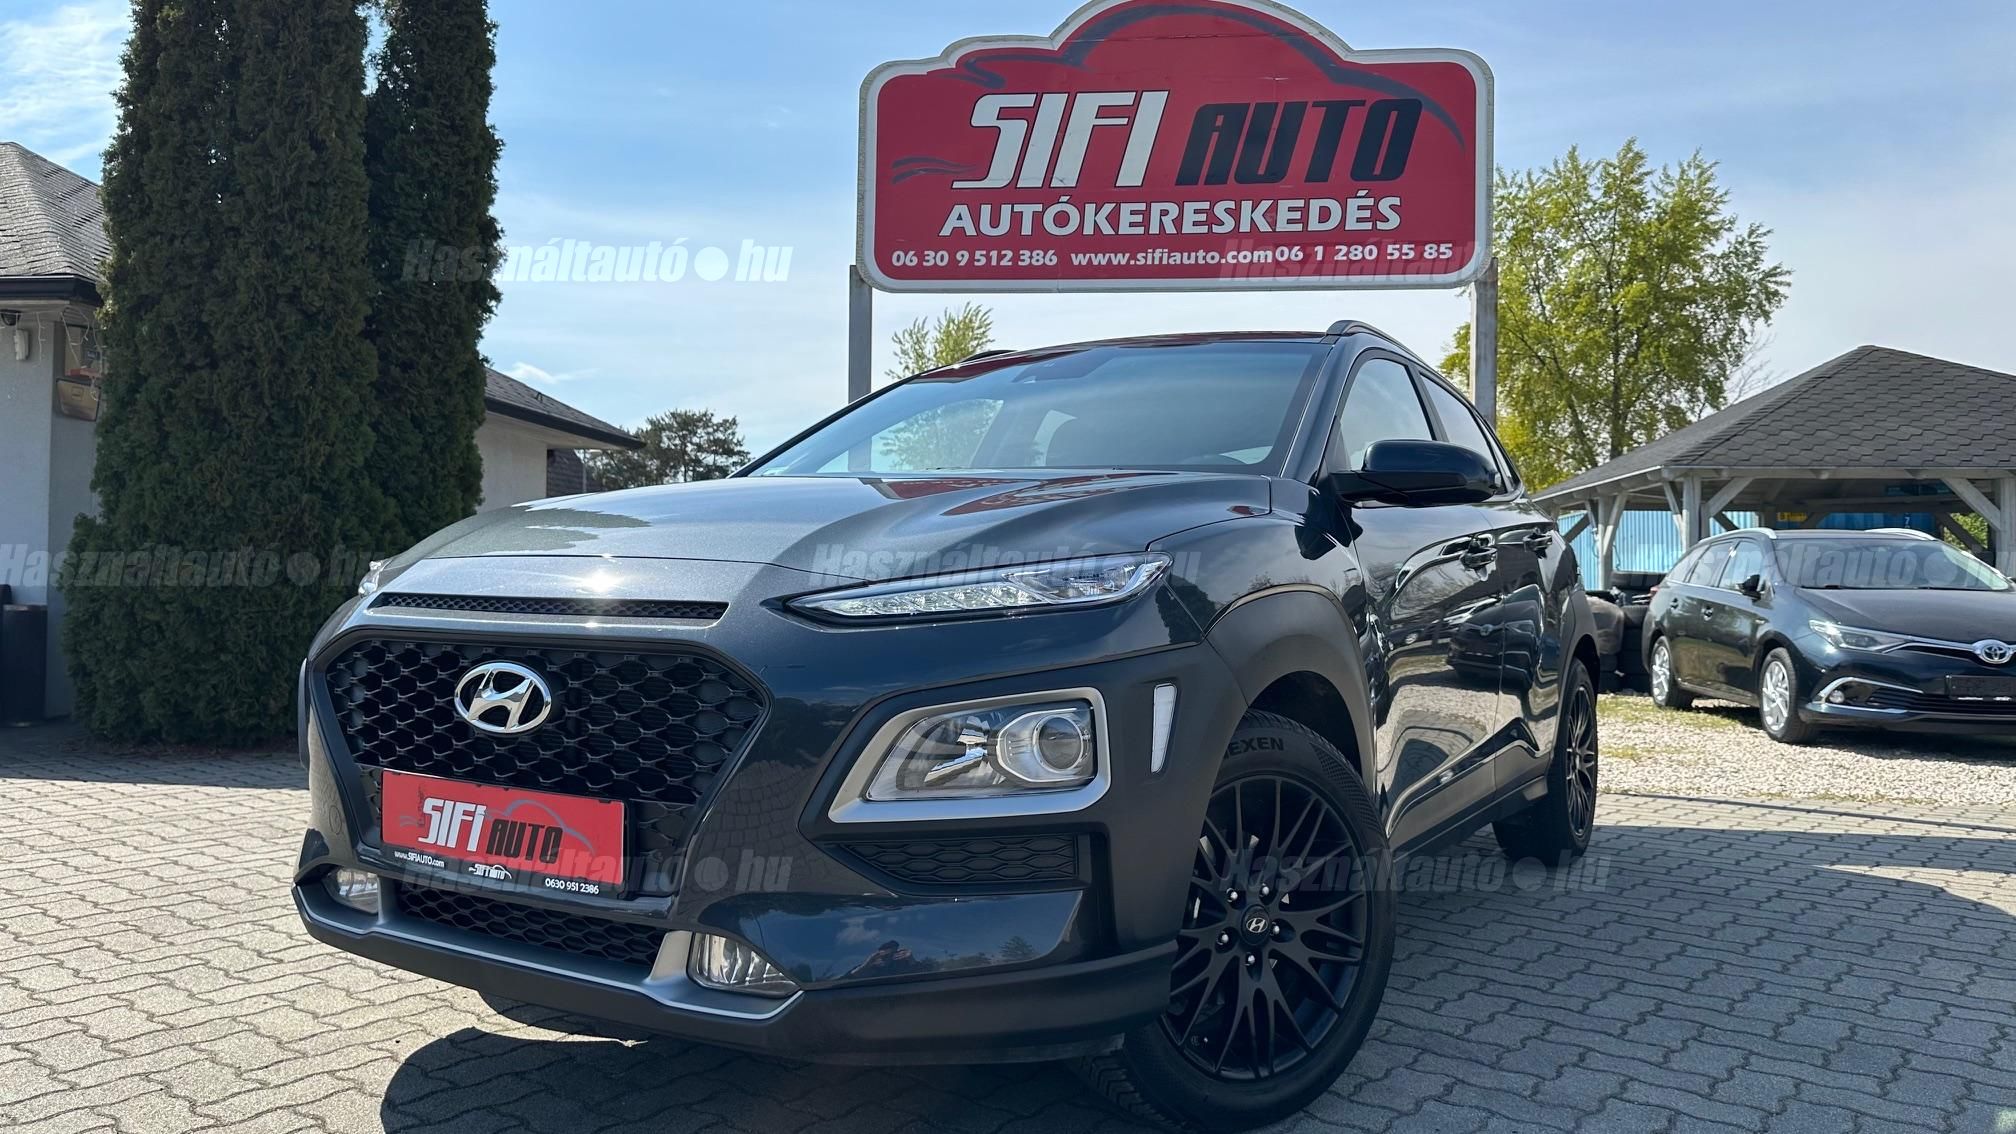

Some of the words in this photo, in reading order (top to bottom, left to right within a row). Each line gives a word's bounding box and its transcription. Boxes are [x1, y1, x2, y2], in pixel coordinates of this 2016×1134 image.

[951, 89, 1170, 190] SIFI
[1175, 98, 1424, 187] AUTO
[938, 190, 1402, 237] AUTÓKERESKEDÉS
[892, 250, 918, 266] 06
[922, 250, 949, 266] 30
[1018, 249, 1058, 266] 386
[1070, 247, 1273, 266] www.sifiauto.com
[1275, 245, 1304, 262] 06
[1314, 245, 1323, 261] 1
[1334, 244, 1378, 261] 280
[1386, 243, 1415, 260] 55
[1423, 242, 1453, 260] 85
[486, 818, 563, 864] AUTO
[394, 851, 445, 868] www.SIFIAUTO.com
[545, 878, 565, 889] 0630
[566, 881, 579, 891] 951
[580, 883, 600, 895] 2386
